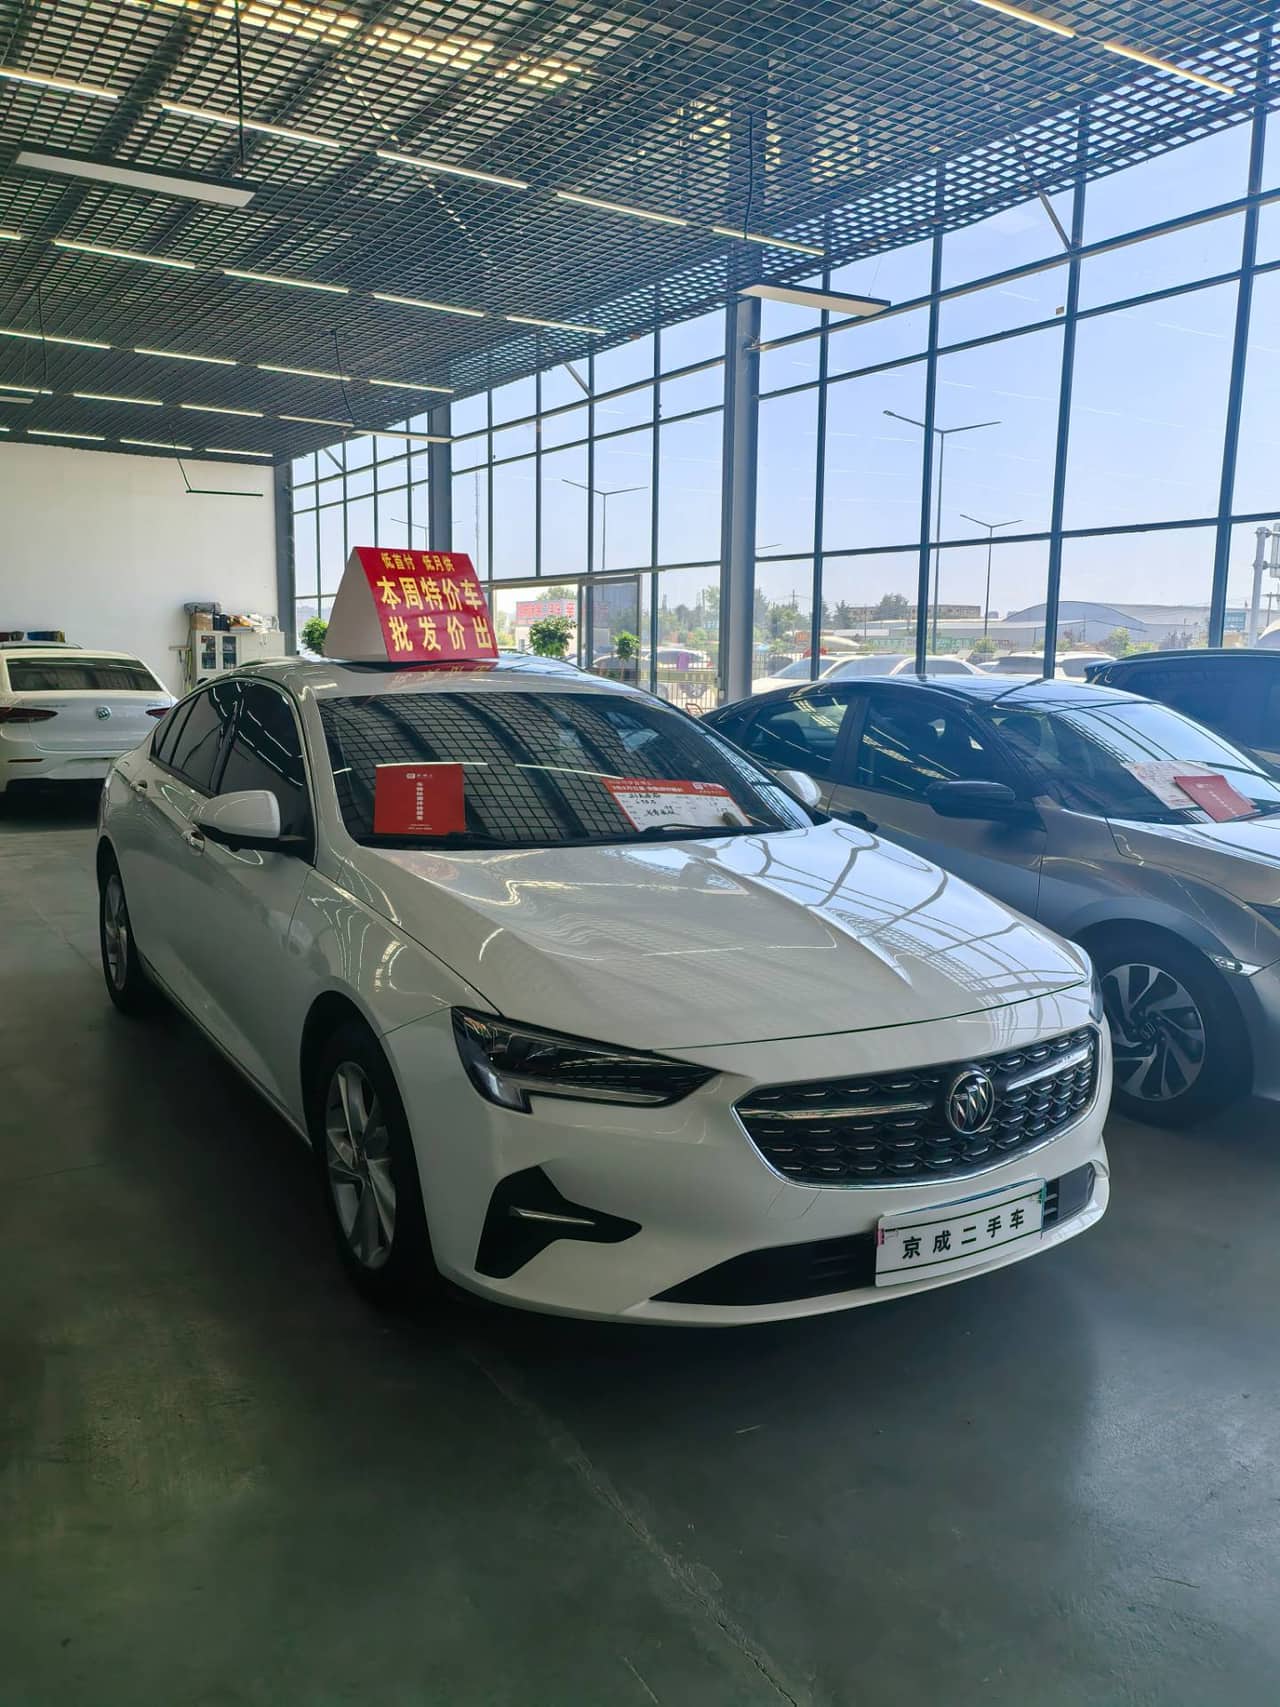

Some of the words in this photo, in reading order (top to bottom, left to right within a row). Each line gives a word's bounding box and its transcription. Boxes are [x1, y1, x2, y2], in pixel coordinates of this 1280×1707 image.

[377, 576, 483, 610] 本周特价车
[388, 615, 493, 652] 批发价出
[902, 1208, 1025, 1259] 京成二手车
